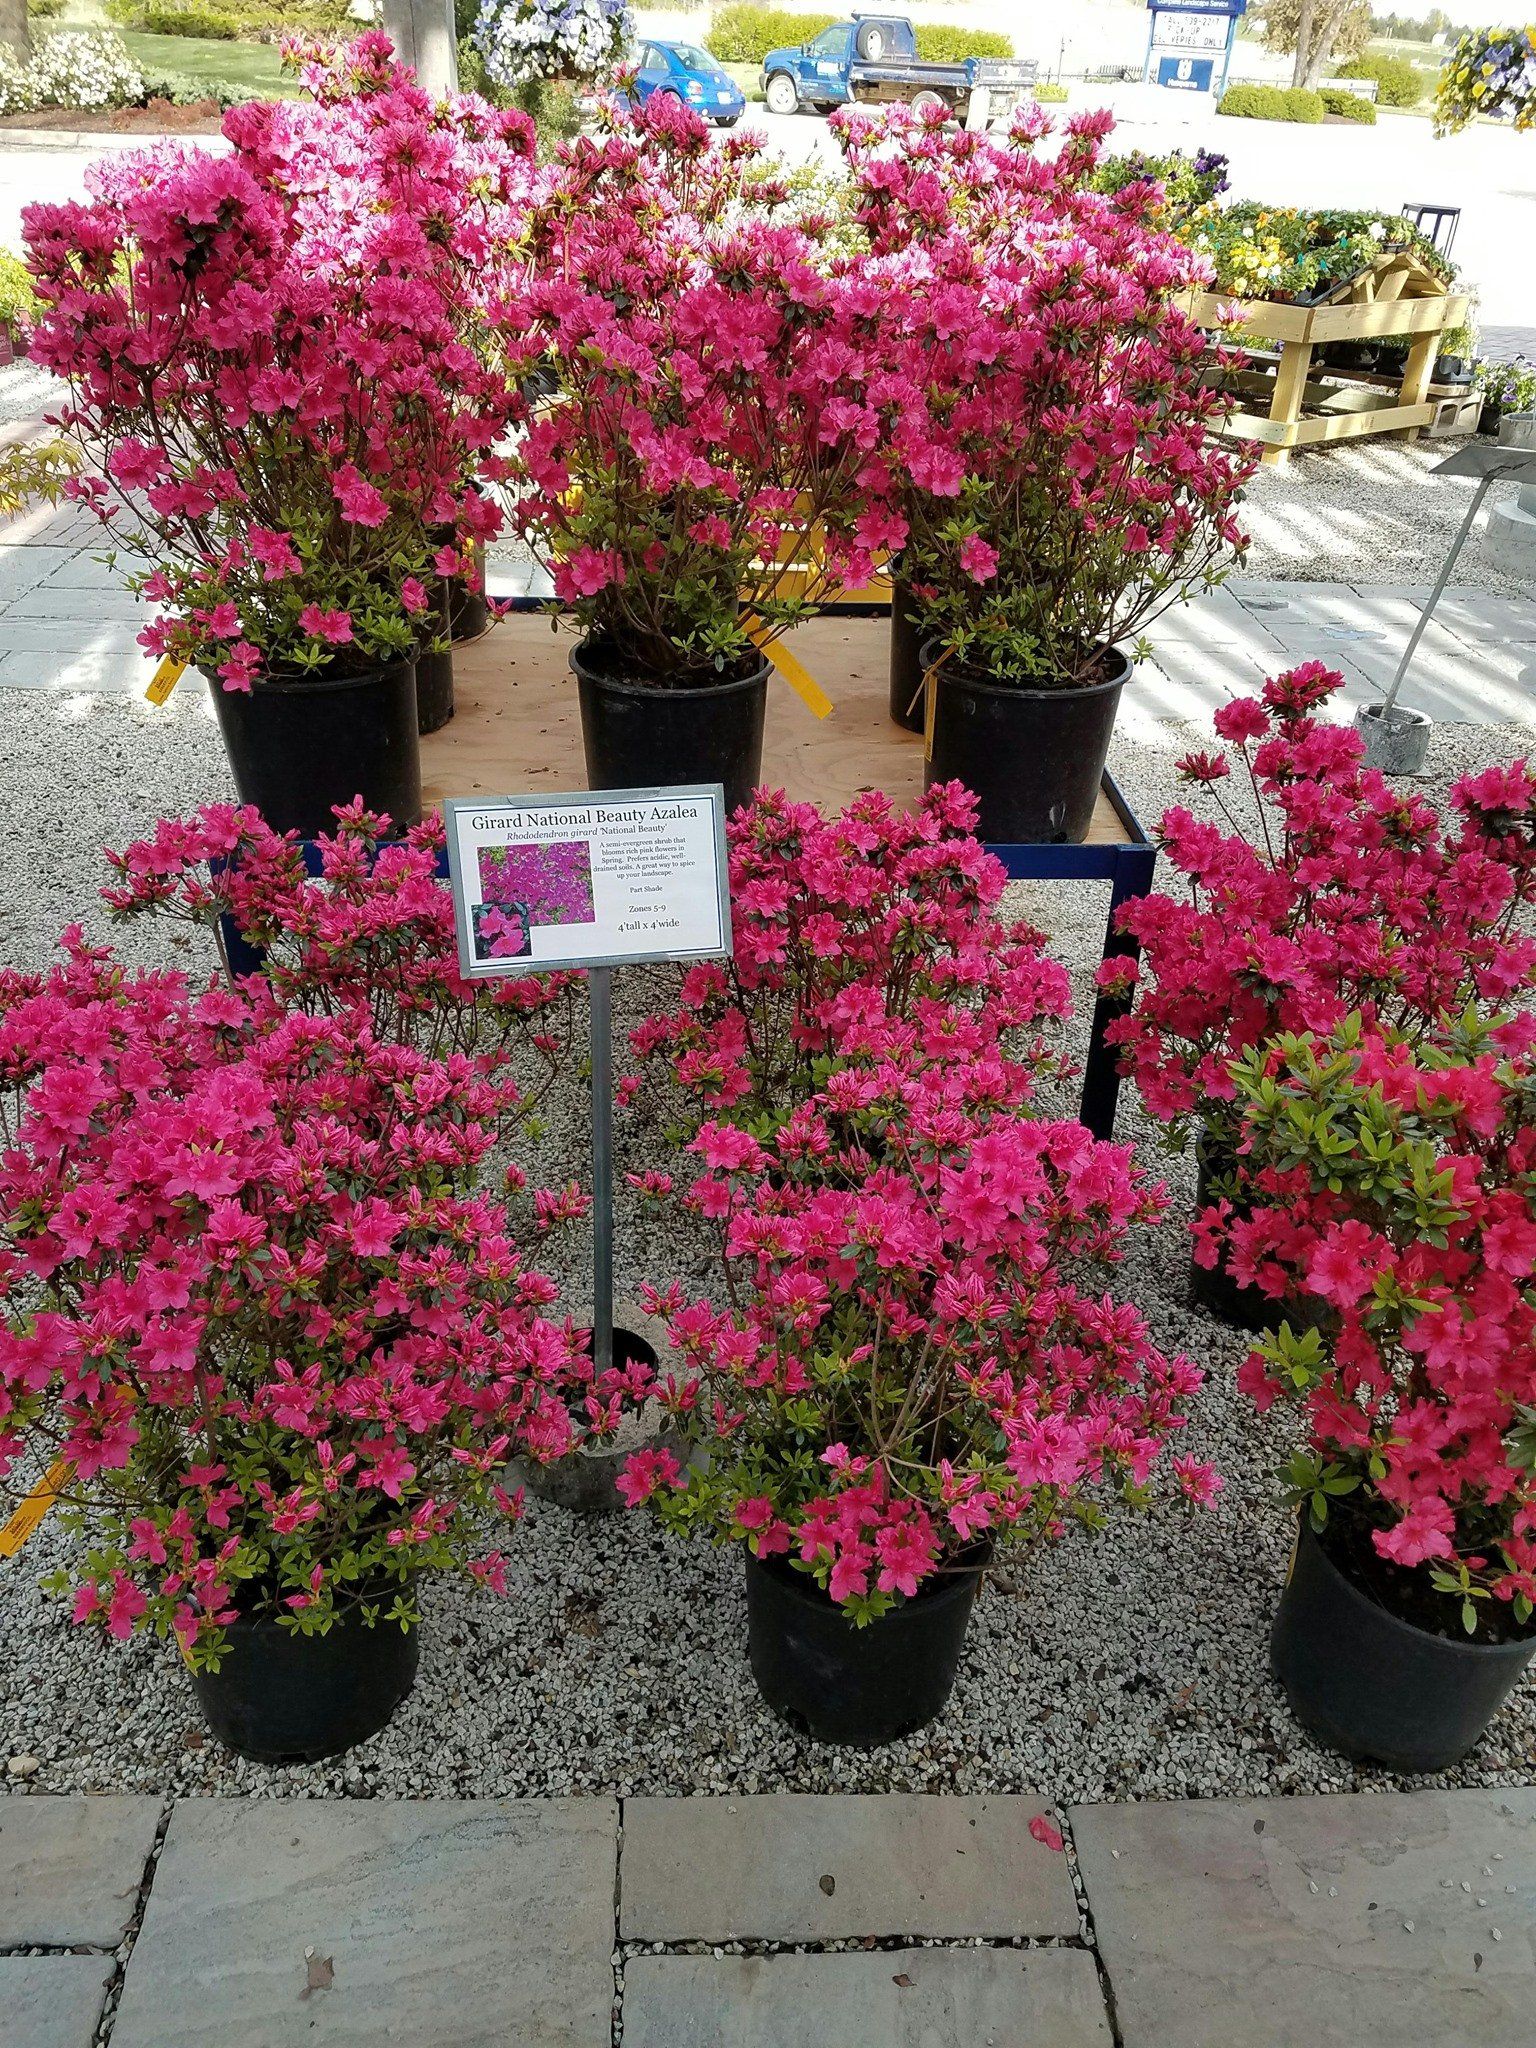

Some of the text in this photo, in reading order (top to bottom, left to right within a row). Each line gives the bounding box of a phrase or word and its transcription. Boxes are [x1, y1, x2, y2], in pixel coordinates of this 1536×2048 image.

[472, 804, 698, 830] Girard National Beauty Azalea
[507, 829, 569, 840] Rhododendron
[571, 827, 598, 838] girard
[606, 839, 653, 848] semi-evergreen
[654, 837, 673, 845] shrub
[639, 846, 654, 855] pink
[654, 845, 677, 853] flowers
[601, 852, 686, 865] Spring. Prefers acidic, well-
[593, 864, 617, 872] drained
[618, 863, 634, 871] soils.
[641, 862, 658, 871] great
[658, 861, 671, 869] way
[679, 859, 696, 868] spice
[625, 872, 640, 880] your
[641, 870, 674, 879] landscape.
[628, 904, 667, 913] Zones 5-9
[618, 918, 680, 932] 4'tall x 4'wide
